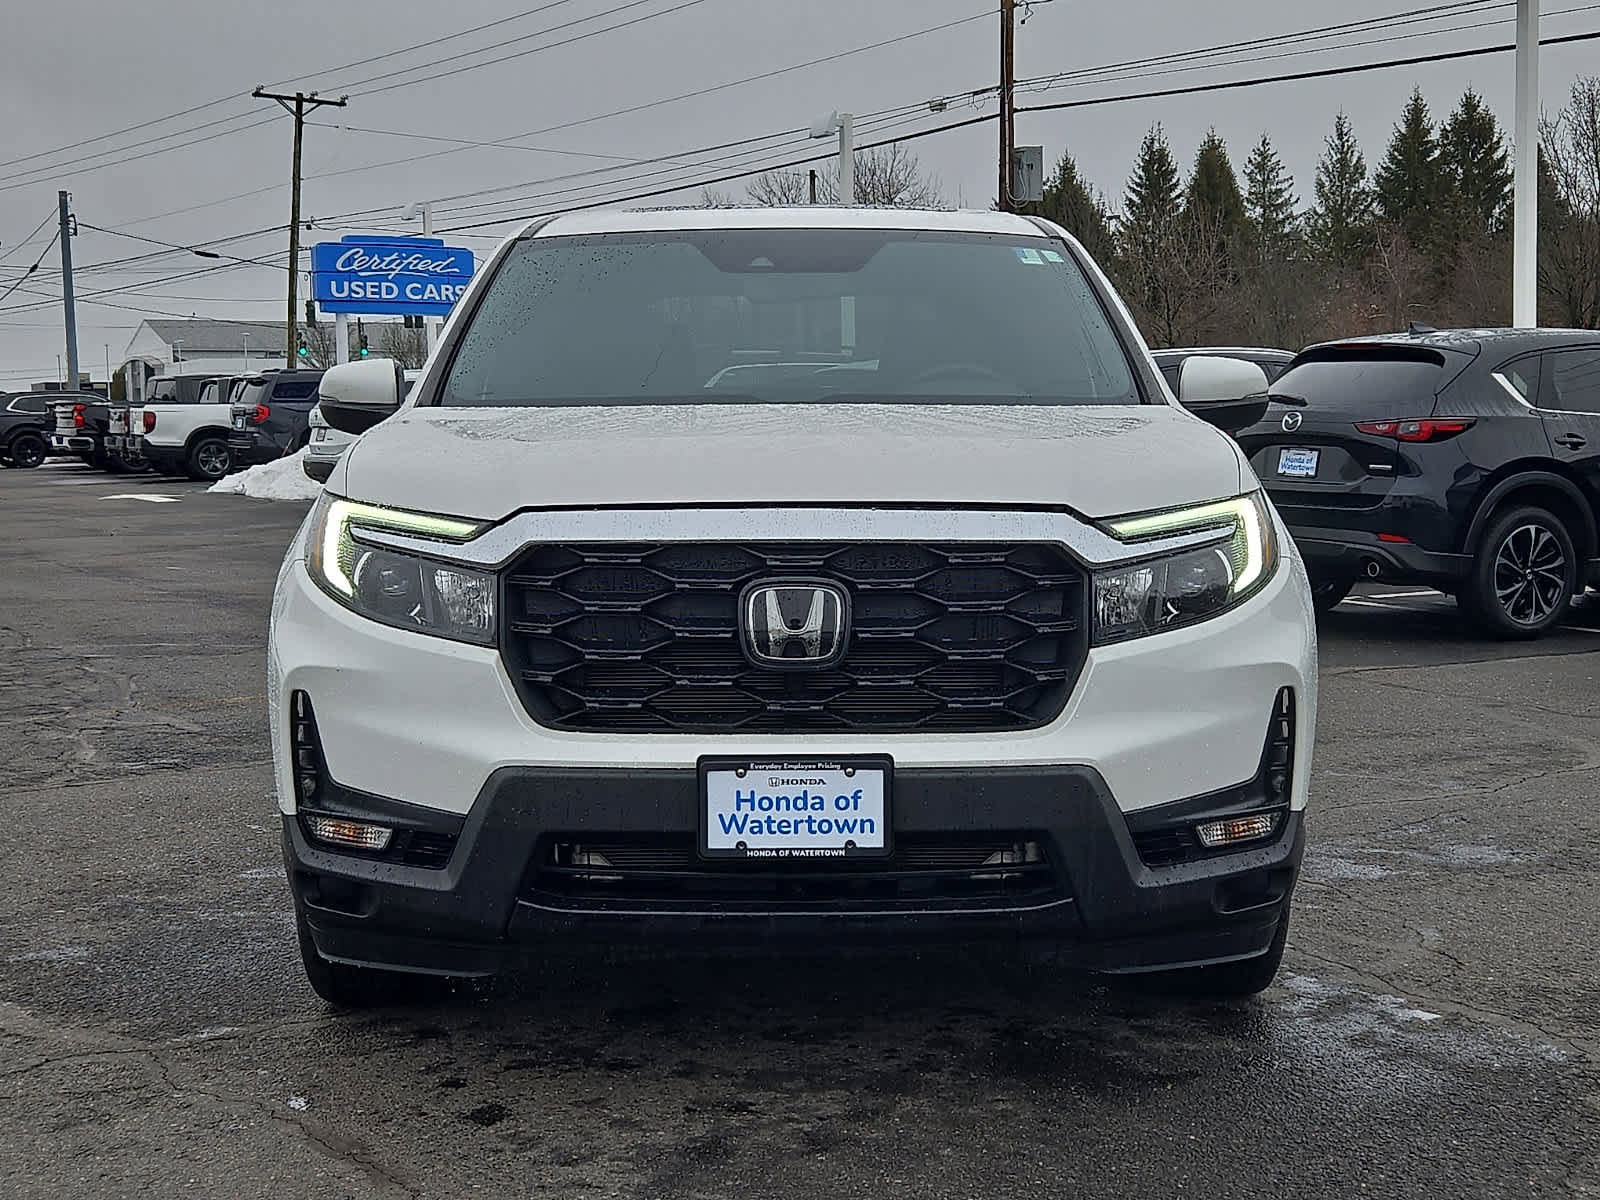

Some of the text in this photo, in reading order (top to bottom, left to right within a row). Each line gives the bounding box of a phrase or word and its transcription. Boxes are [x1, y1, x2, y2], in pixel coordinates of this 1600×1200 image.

[335, 248, 460, 280] Certified
[330, 280, 399, 299] USED
[735, 789, 863, 811] Honda of
[718, 813, 875, 835] Watertown
